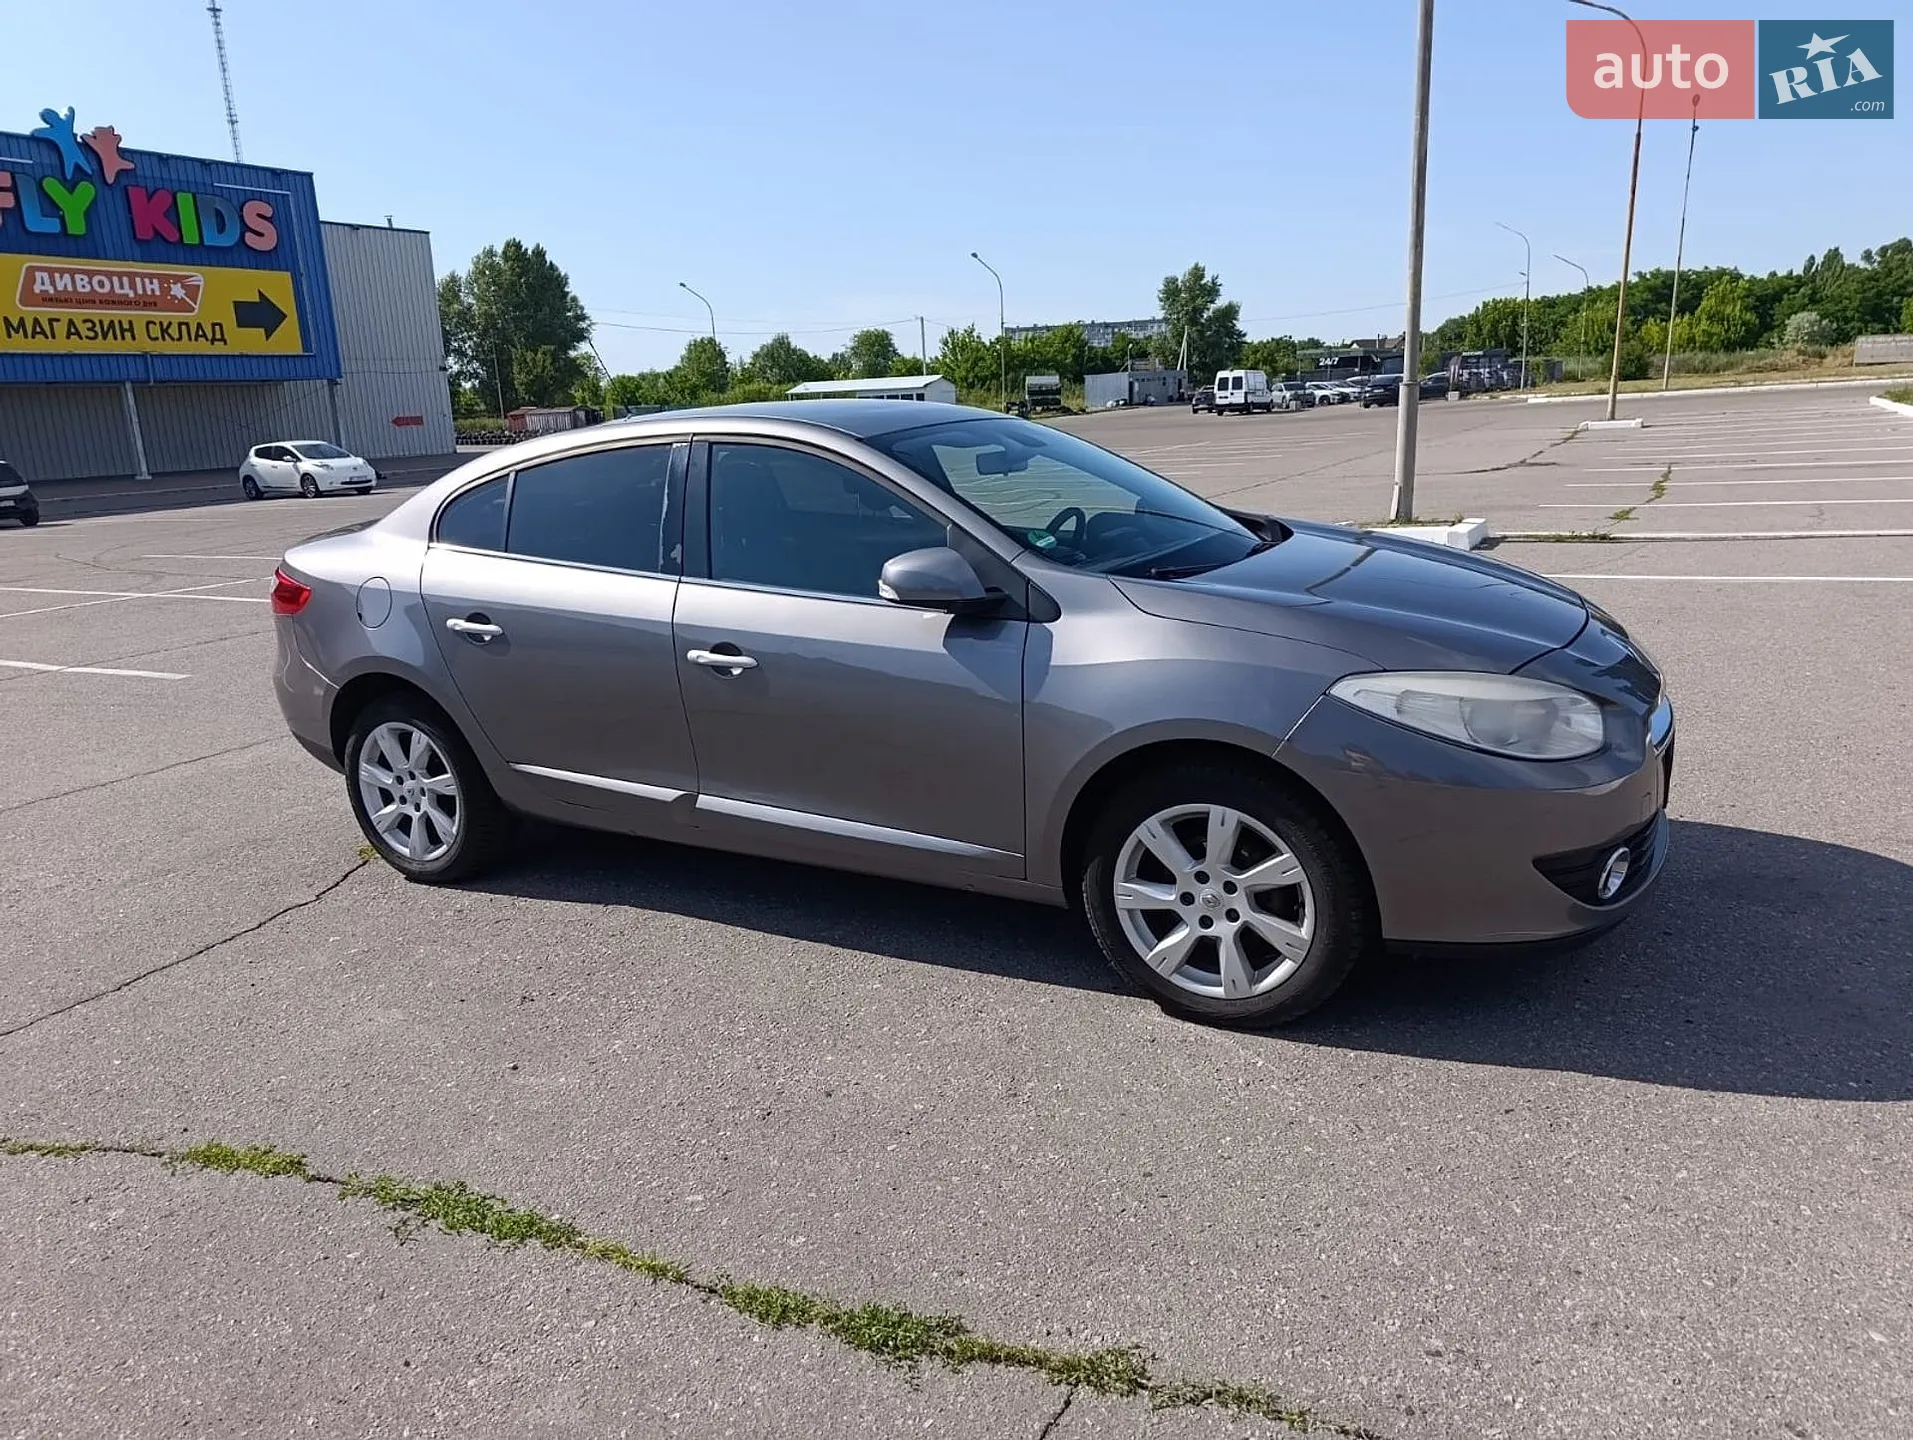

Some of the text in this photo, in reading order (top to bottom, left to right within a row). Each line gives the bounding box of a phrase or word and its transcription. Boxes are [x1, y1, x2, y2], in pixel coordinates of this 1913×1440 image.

[127, 184, 279, 251] KIDS
[33, 271, 161, 297] ДИВОЦІН
[3, 316, 228, 345] МАГАЗИН СКЛАД
[1318, 356, 1339, 366] 24/7
